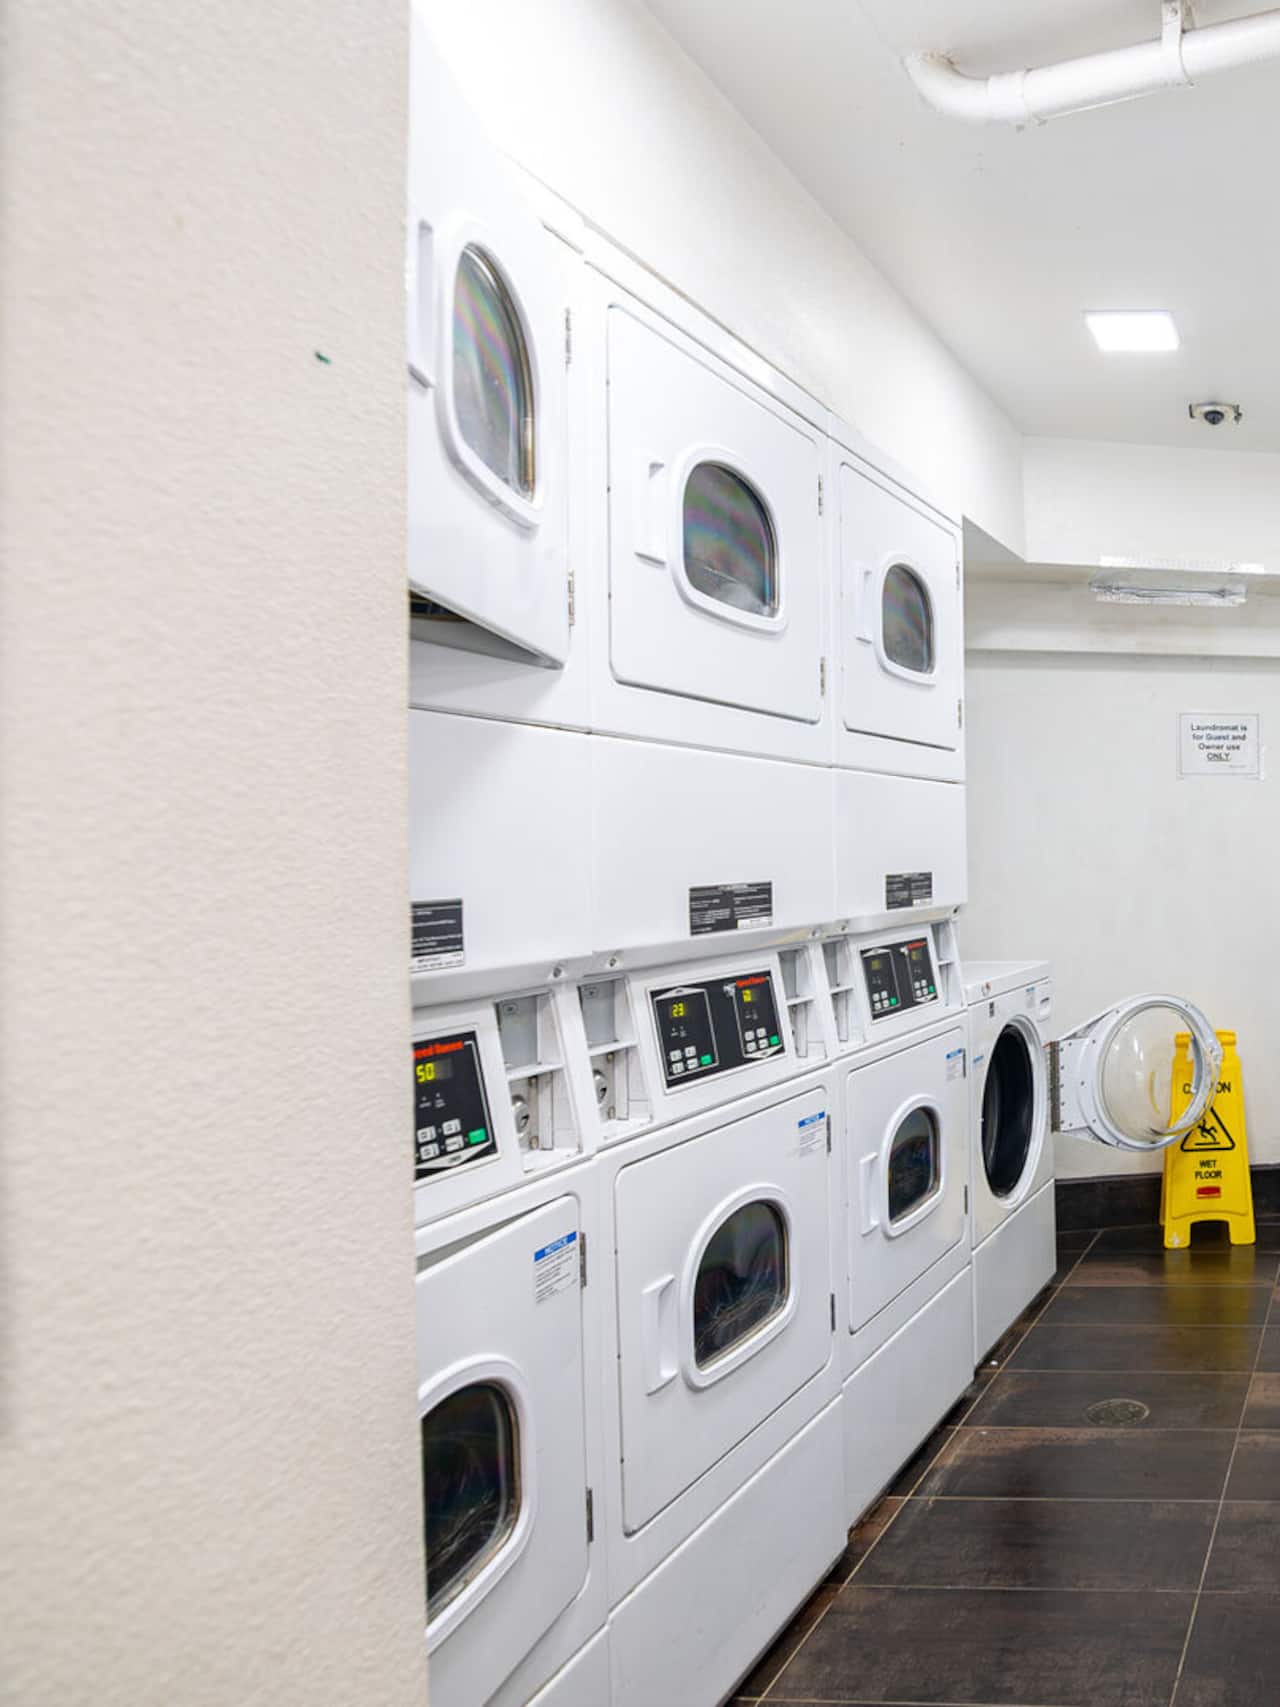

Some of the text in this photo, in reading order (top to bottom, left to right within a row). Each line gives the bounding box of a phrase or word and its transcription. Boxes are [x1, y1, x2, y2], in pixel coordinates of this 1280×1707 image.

[1191, 723, 1238, 731] Laundromat
[1207, 752, 1230, 760] ONLY
[1199, 1160, 1217, 1168] WET
[1195, 1170, 1222, 1179] FLOOR
